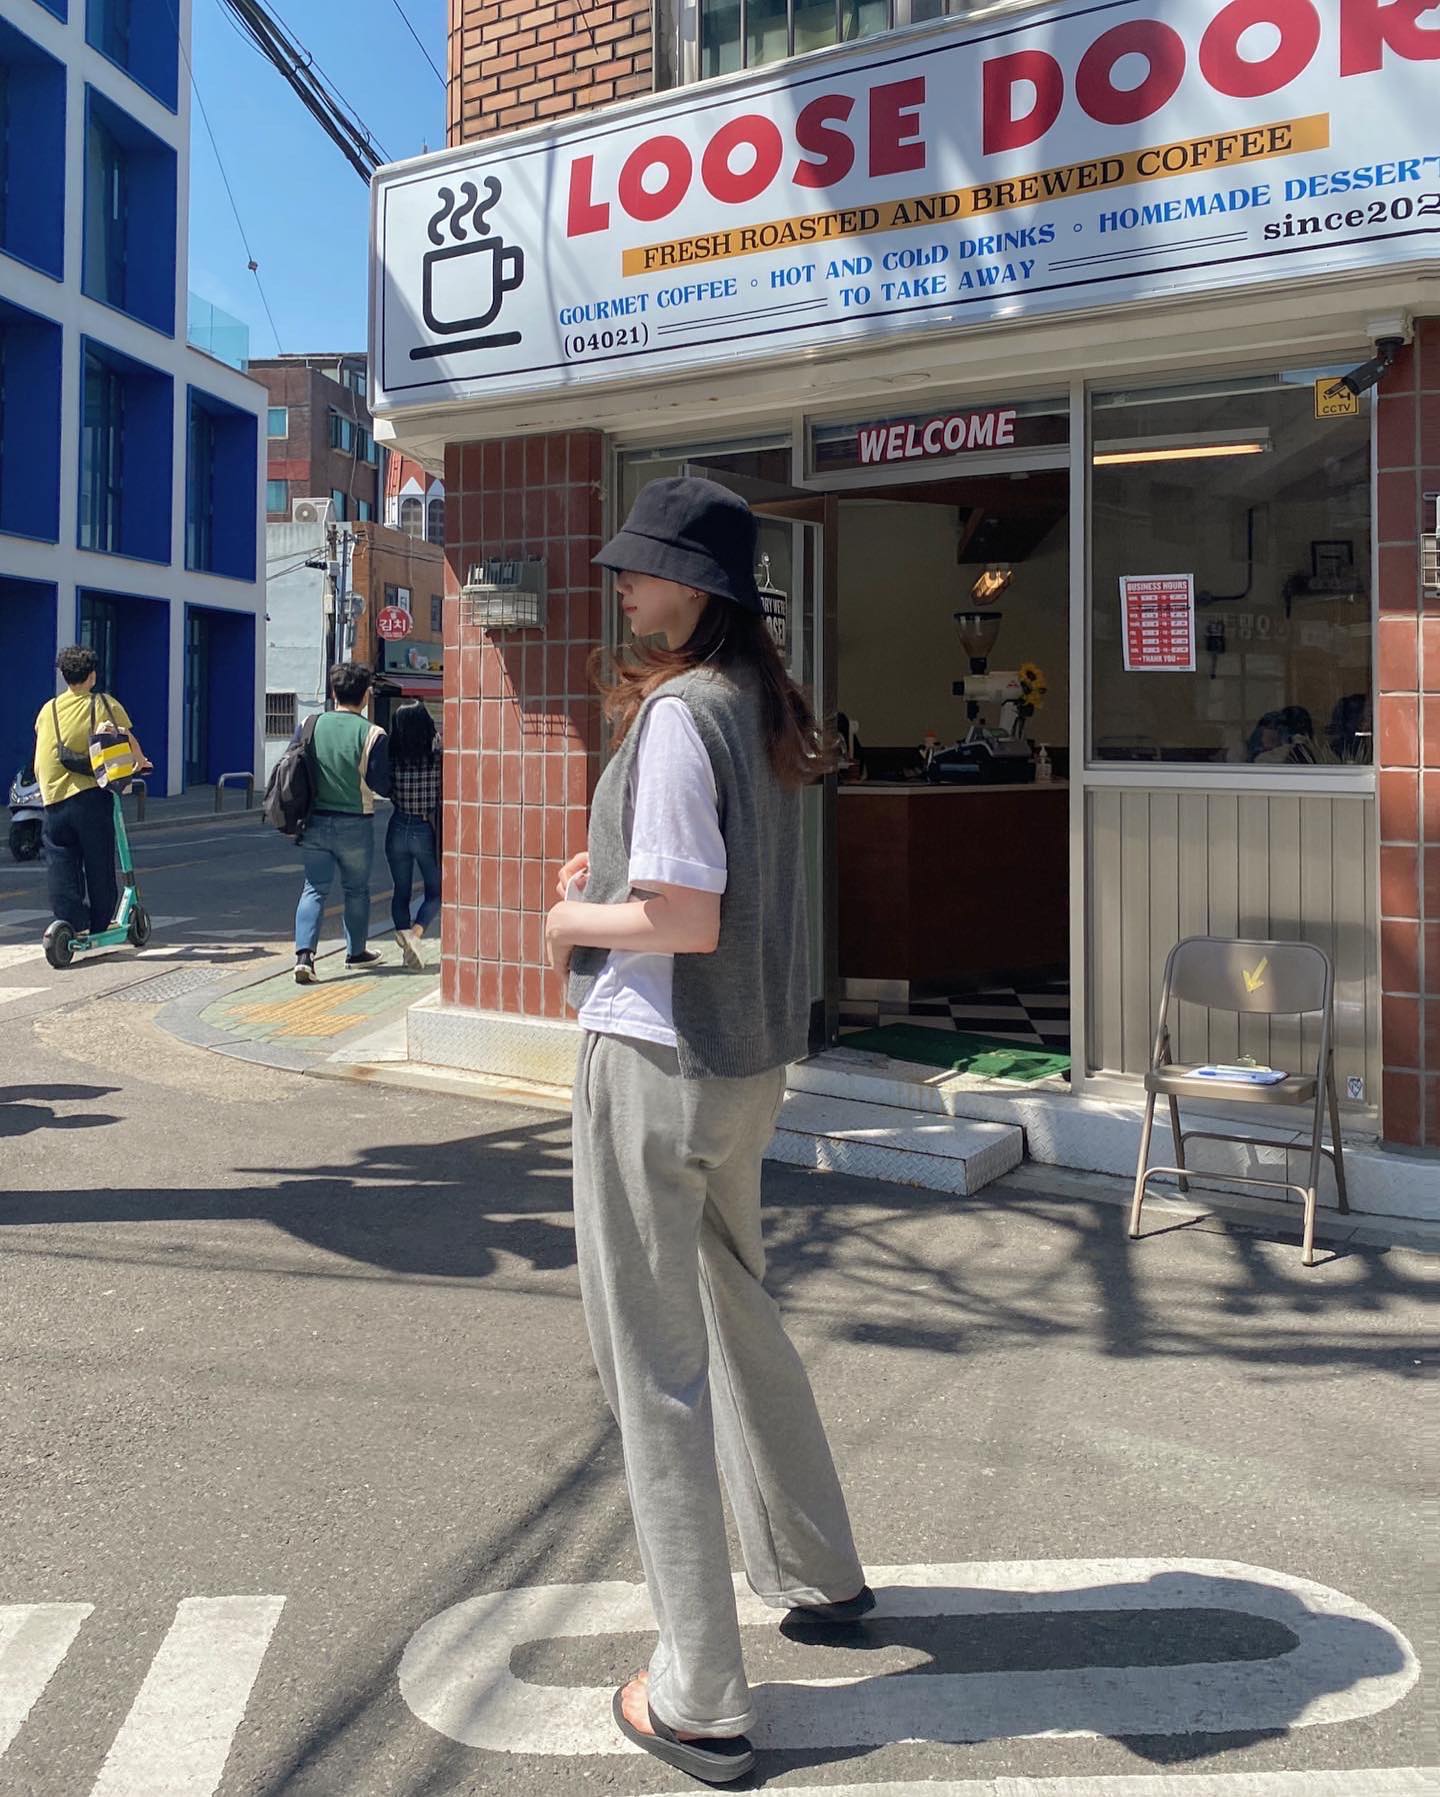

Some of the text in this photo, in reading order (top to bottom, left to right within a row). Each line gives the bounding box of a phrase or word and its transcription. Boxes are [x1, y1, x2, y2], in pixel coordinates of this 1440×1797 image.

[567, 76, 926, 238] LOOSE
[644, 124, 1292, 269] FRESH ROASTED AND BREWED COFFEE
[559, 294, 649, 326] GOURMET
[656, 278, 738, 308] COFFEE
[771, 264, 816, 288] HOT
[825, 256, 873, 279] AND
[883, 244, 949, 271] COLD
[959, 223, 1055, 260] DRINKS
[1099, 184, 1271, 233] HOMEMADE
[840, 259, 1035, 307] TO TAKE AWAY
[565, 322, 649, 359] (04021)
[1323, 403, 1351, 414] CCTV
[860, 410, 1017, 464] WELCOME
[1127, 581, 1187, 591] BUSINESS HOURS
[379, 619, 406, 631] 김치
